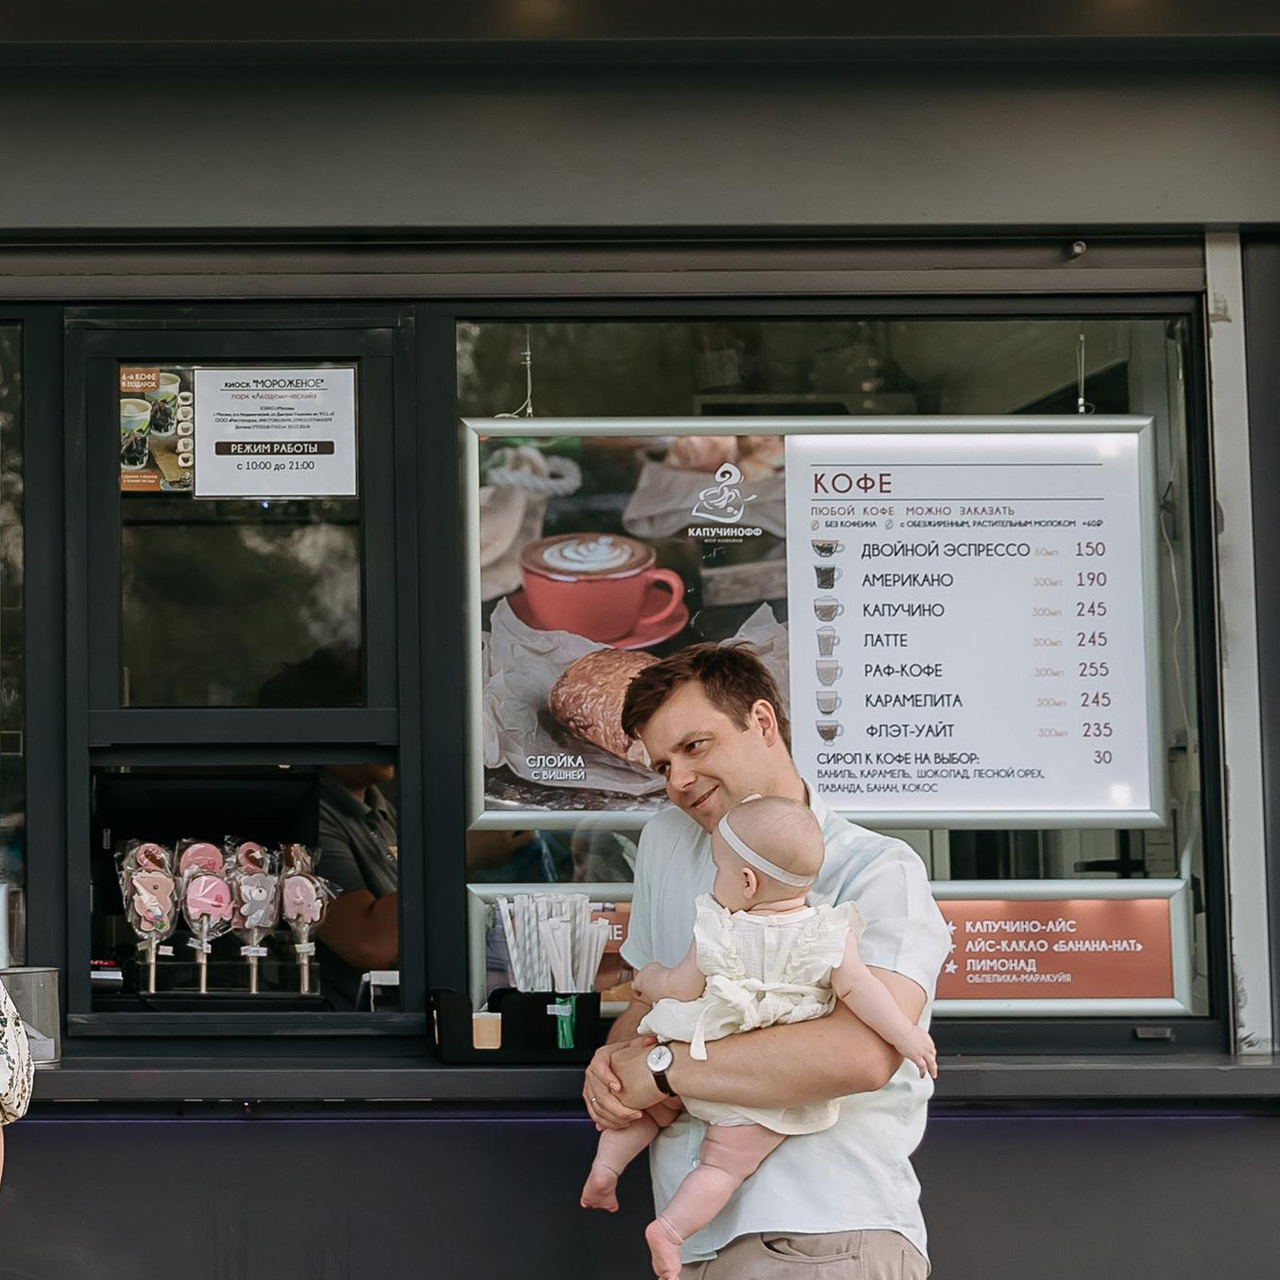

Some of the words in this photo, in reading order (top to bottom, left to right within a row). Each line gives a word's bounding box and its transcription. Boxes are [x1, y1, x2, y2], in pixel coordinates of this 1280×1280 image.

[136, 373, 157, 381] КОФЕ
[231, 444, 270, 453] РЕЖИМ
[274, 443, 318, 453] РАБОТЫ
[246, 461, 272, 470] 10:00
[274, 462, 286, 472] до
[289, 461, 315, 470] 21:00
[814, 474, 892, 494] КОФЕ
[811, 505, 855, 516] ЛЮБОЙ
[863, 507, 894, 516] КОФЕ
[906, 507, 952, 516] МОЖНО
[960, 506, 1015, 516] ЗАКАЗАТЬ
[688, 528, 762, 536] КАПУЧИНОФФ
[861, 540, 939, 560] ДВОЙНОЙ
[943, 543, 1030, 557] ЭСПРЕССО
[1076, 542, 1105, 556] 150
[862, 574, 953, 587] АМЕРИКАНО
[1076, 572, 1107, 586] 190
[863, 604, 945, 617] КАПУЧИНО
[1076, 602, 1107, 616] 245
[864, 634, 908, 647] ЛАТТЕ
[1077, 632, 1107, 646] 245
[865, 664, 943, 678] РАФ-КОФЕ
[1079, 662, 1109, 677] 255
[865, 694, 962, 708] КАРАМЕЛИТА
[1081, 692, 1111, 707] 245
[866, 721, 954, 738] ФЛЭТ-УАЙТ
[1083, 723, 1113, 737] 235
[526, 754, 586, 768] СЛОЙКА
[817, 753, 862, 764] СИРОП
[865, 753, 873, 764] К
[876, 753, 911, 764] КОФЕ
[914, 753, 931, 764] НА
[934, 753, 980, 764] ВЫБОР:
[1094, 751, 1112, 764] 30
[532, 770, 540, 780] С
[542, 768, 586, 780] ВИШНЕЙ
[972, 768, 1015, 778] ЛЕСНОЙ
[902, 784, 938, 792] КОКОС
[965, 918, 1077, 933] КАПУЧИНО-АЙС
[965, 937, 1048, 953] АЙС-КАКАО
[1052, 939, 1143, 952] «БАНАНА-НАТ»
[966, 959, 1037, 972] ЛИМОНАД
[966, 972, 1072, 984] ОБЛЕПИХА-МАРАКУЙЯ
